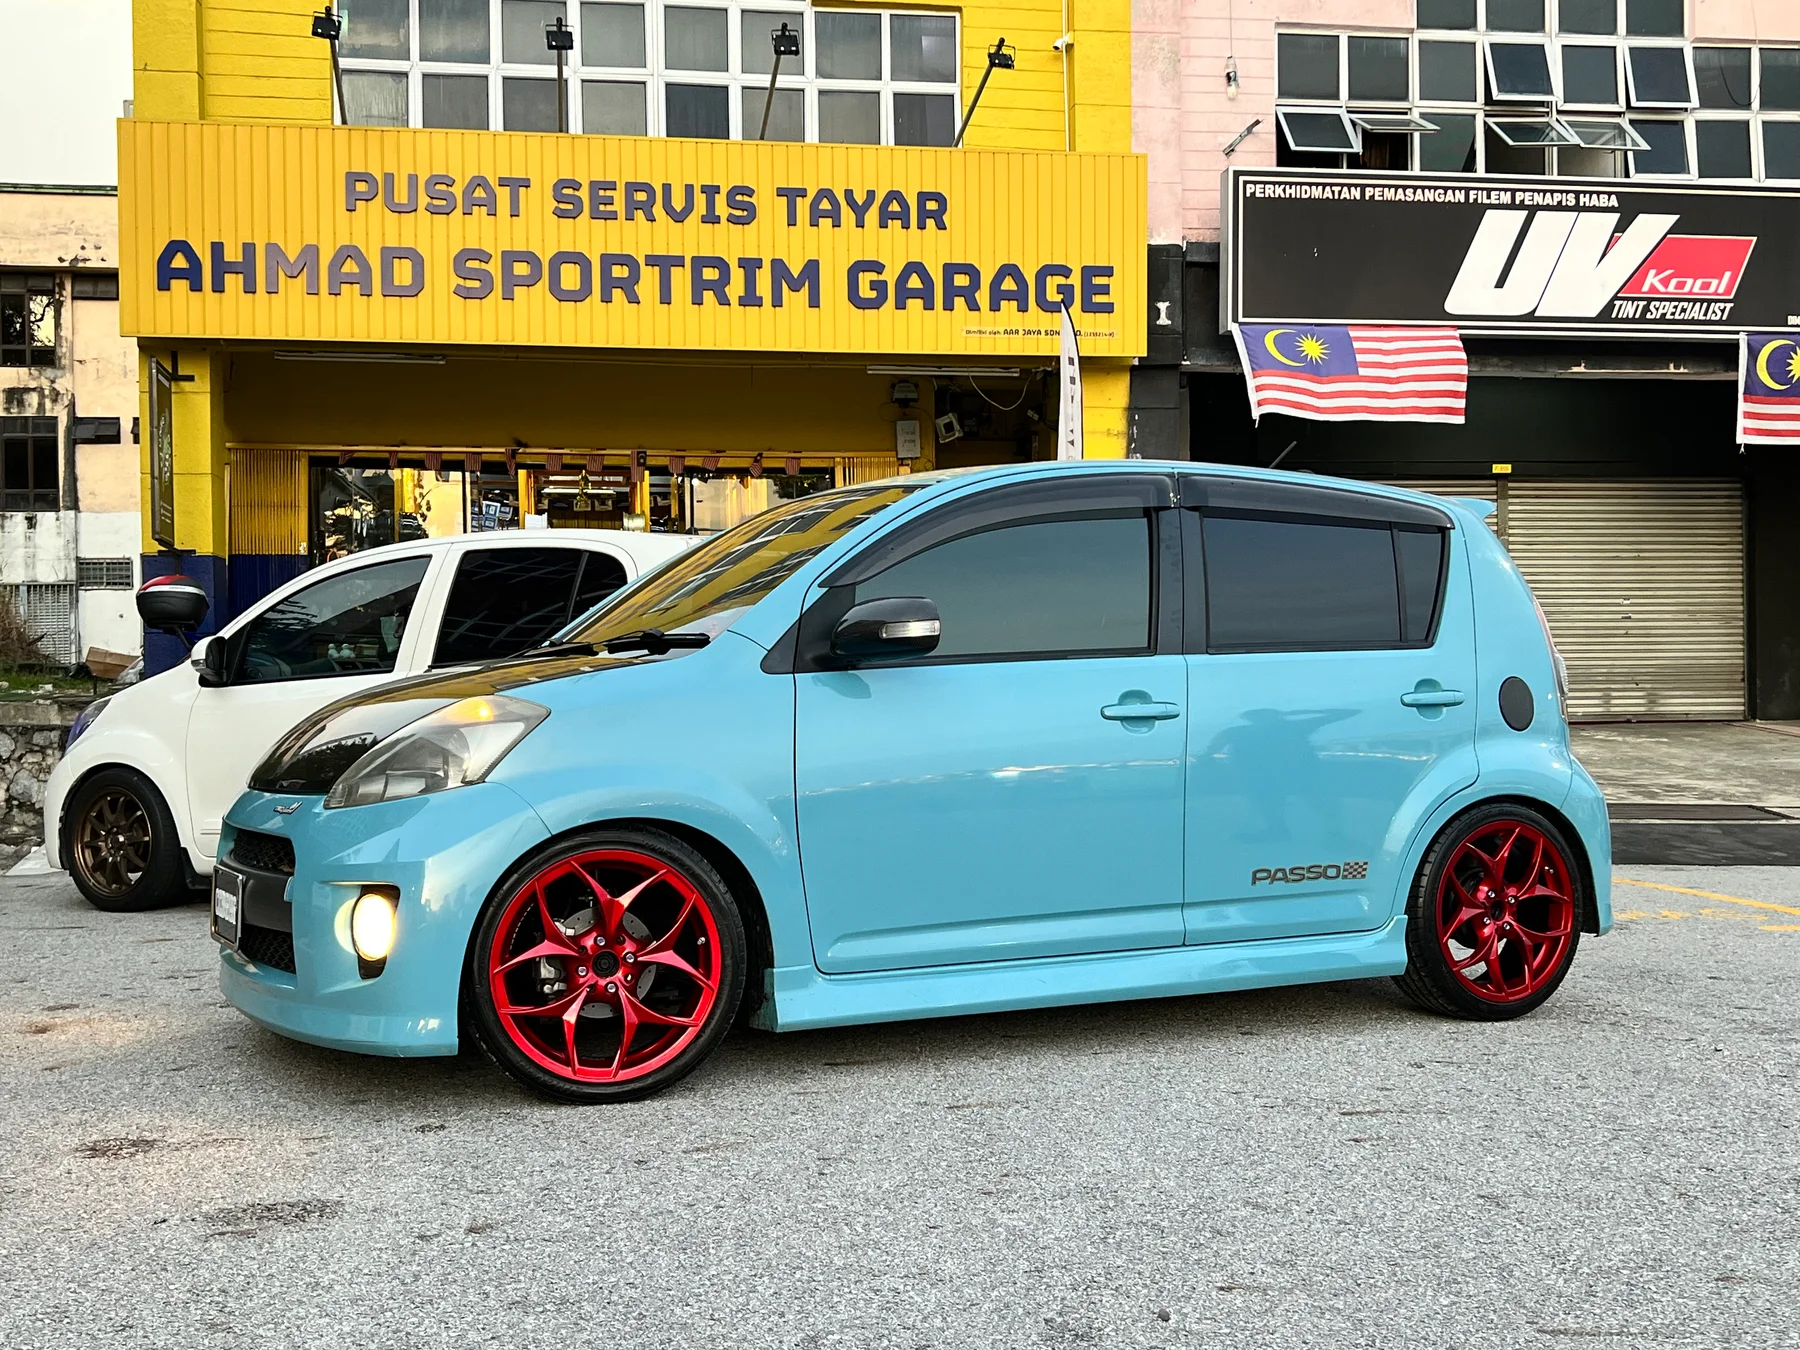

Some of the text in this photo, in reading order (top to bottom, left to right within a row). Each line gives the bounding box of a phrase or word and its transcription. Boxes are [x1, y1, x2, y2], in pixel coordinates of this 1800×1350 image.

[345, 171, 948, 231] PUSAT SERVIS TAYAR
[1245, 183, 1619, 208] PERKHIDMATAN PEMASANGAN FILEM PENAPIS HABA
[1444, 209, 1681, 317] UV
[156, 239, 1115, 314] AHMAD SPORTRIM GARAGE
[1641, 268, 1732, 294] Kool
[1611, 300, 1734, 321] TINT SPECIALIST
[1003, 328, 1020, 336] AAR
[1022, 328, 1042, 336] JAYA
[1044, 329, 1061, 337] SDN
[1251, 863, 1342, 886] PASSO
